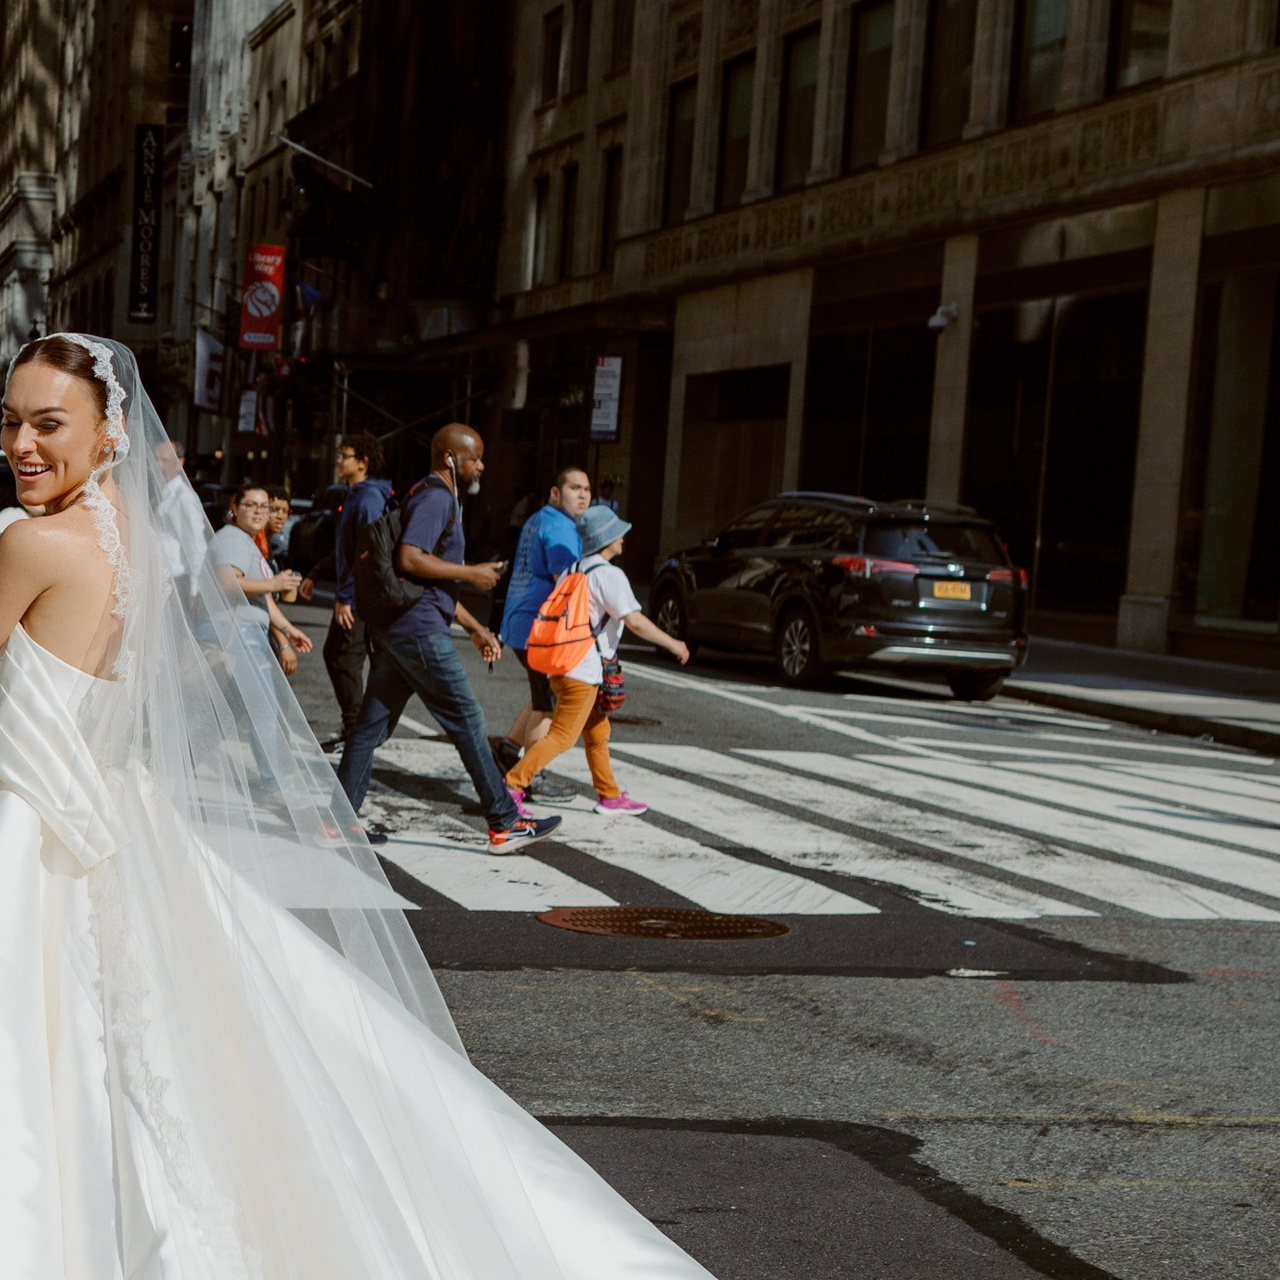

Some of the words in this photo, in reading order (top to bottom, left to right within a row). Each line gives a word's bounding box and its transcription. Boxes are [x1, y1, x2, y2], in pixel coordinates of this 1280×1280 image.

[143, 129, 158, 204] ANNIE
[248, 252, 282, 267] Library
[253, 262, 275, 275] Way
